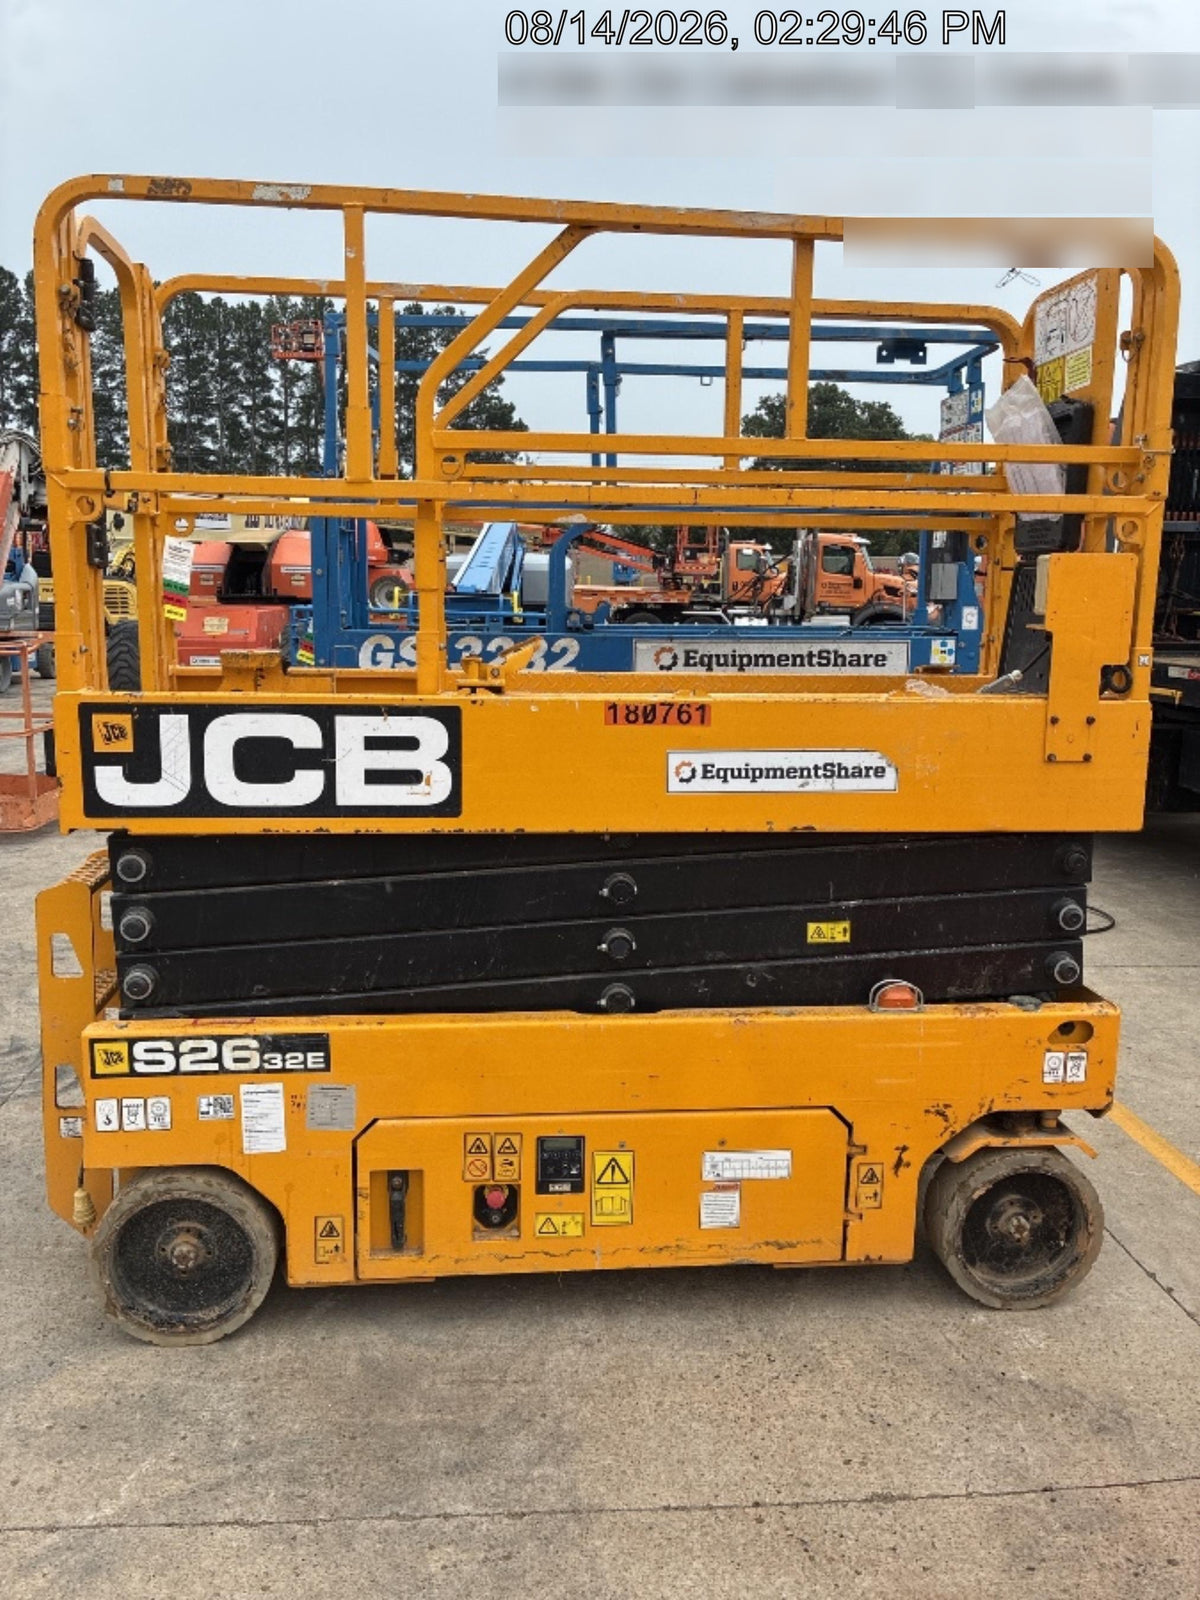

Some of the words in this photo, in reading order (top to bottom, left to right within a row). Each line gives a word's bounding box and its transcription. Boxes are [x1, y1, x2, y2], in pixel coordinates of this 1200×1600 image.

[683, 649, 888, 671] EquipmentShare
[607, 703, 707, 725] 180761
[94, 713, 452, 807] JCB
[701, 763, 886, 783] EquipmentShare
